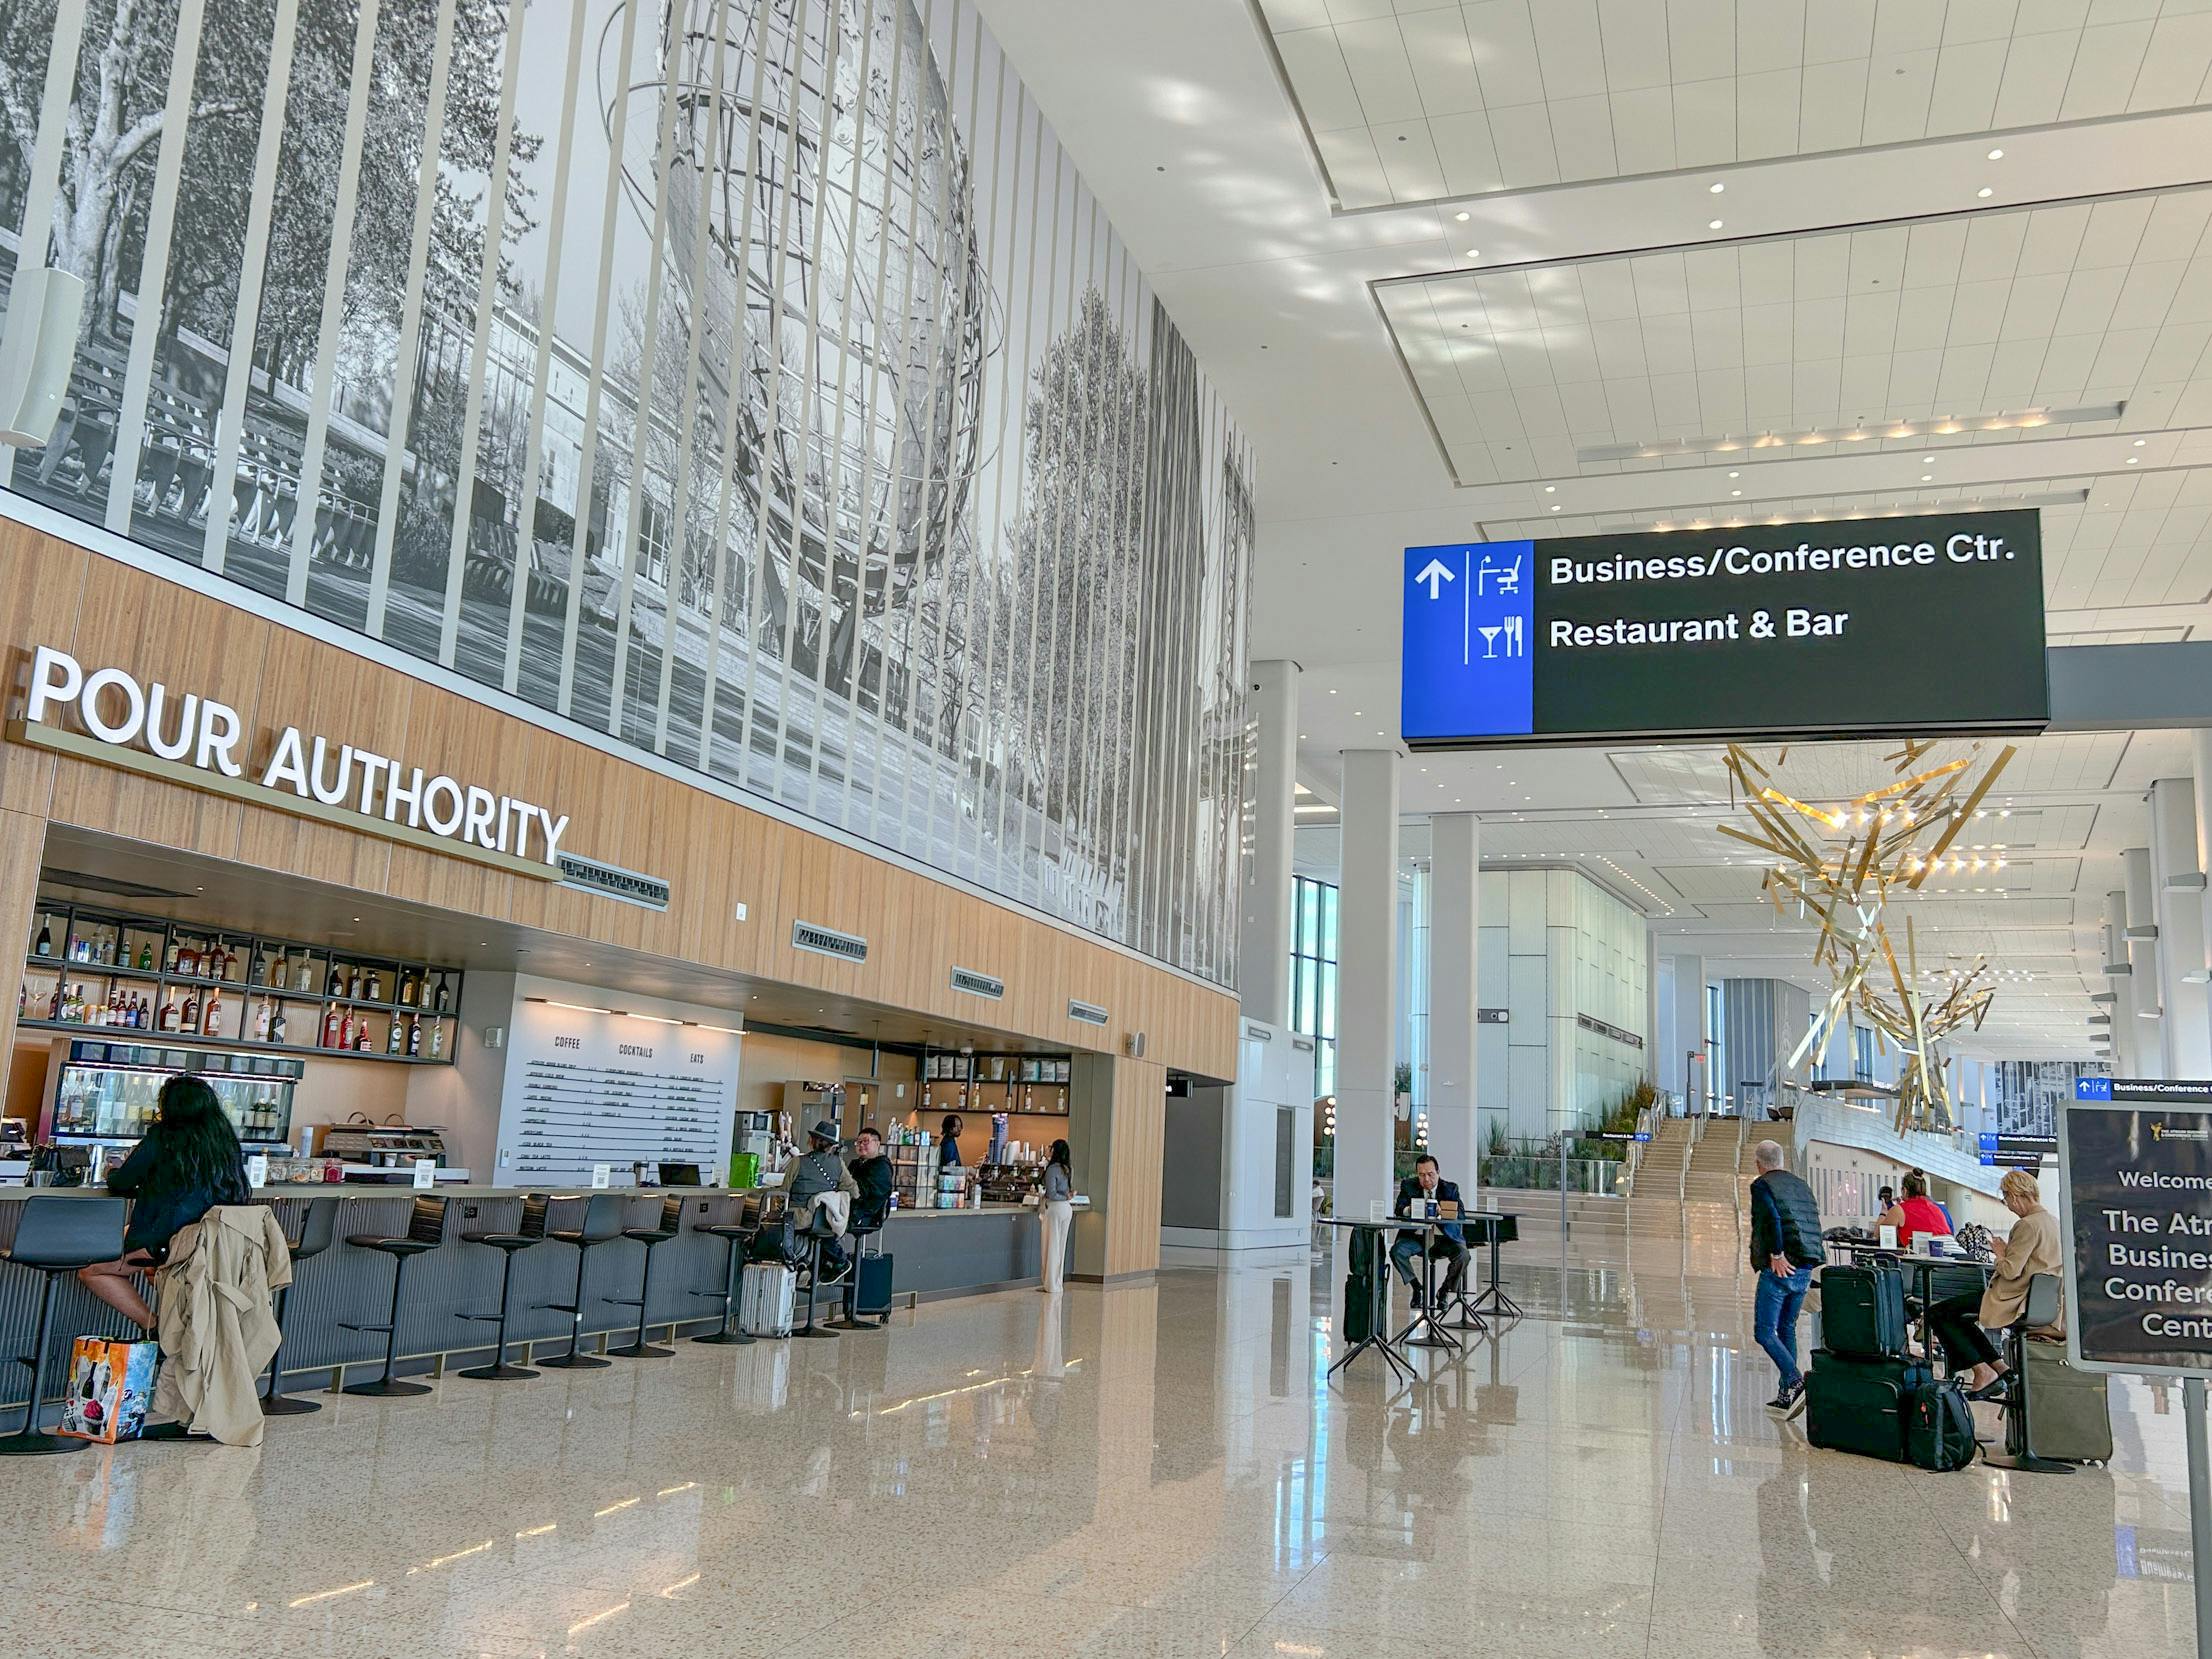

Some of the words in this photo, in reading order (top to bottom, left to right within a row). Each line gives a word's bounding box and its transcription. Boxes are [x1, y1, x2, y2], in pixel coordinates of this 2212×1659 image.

[1550, 541, 1936, 584] Business/Conference
[1945, 533, 2015, 563] Ctr.
[1550, 612, 1739, 647] Restaurant
[1748, 610, 1777, 639] &
[1786, 608, 1849, 637] Bar
[27, 645, 241, 777] POUR
[262, 726, 570, 865] AUTHORITY
[554, 1036, 581, 1050] COFFEE
[618, 1043, 653, 1059] COCKTAILS
[690, 1053, 704, 1064] EATS
[2113, 1083, 2209, 1093] Business/Conference
[2102, 1210, 2159, 1233] The
[2109, 1243, 2212, 1270] Busine
